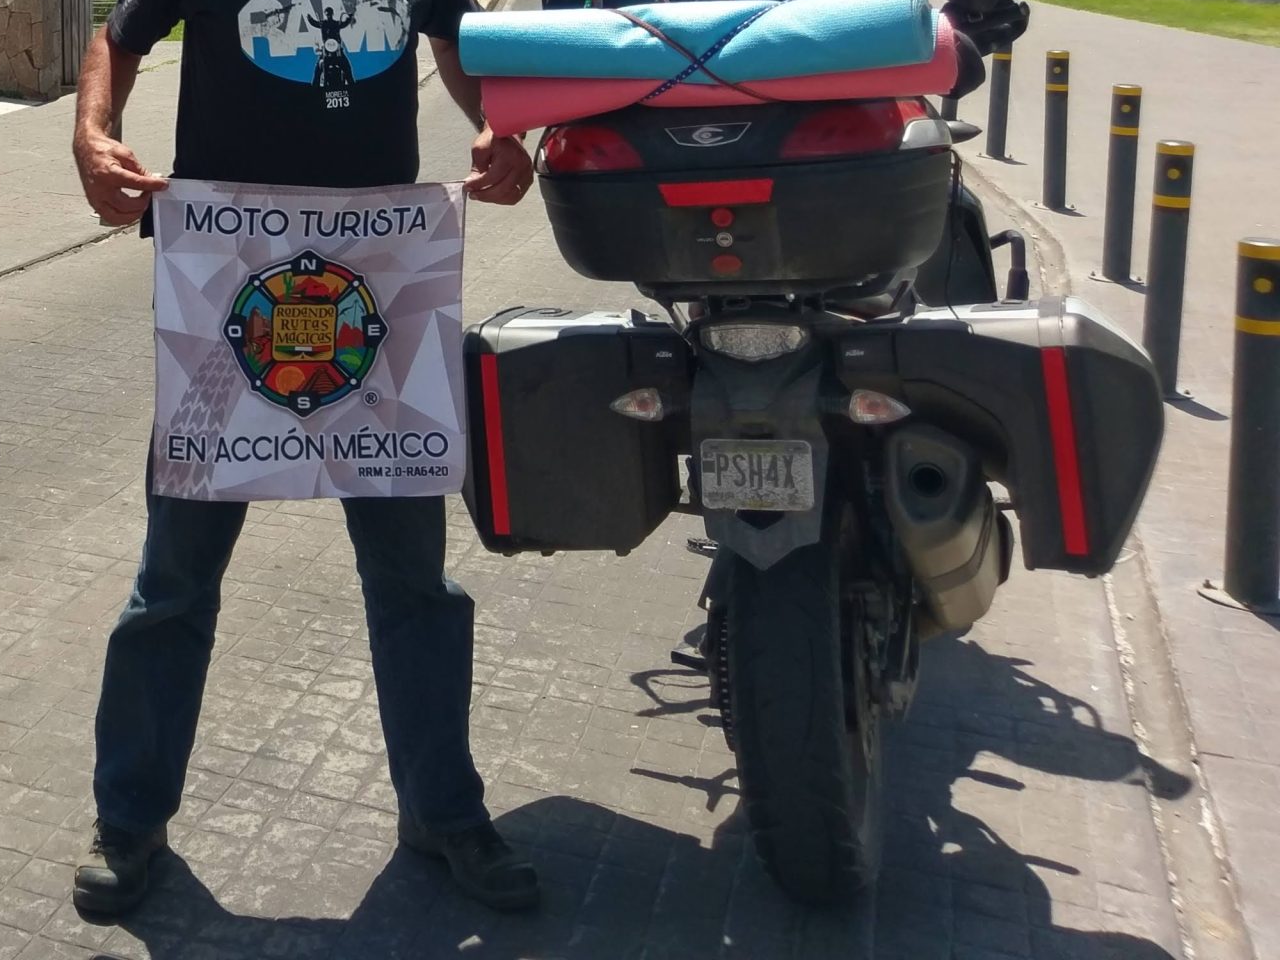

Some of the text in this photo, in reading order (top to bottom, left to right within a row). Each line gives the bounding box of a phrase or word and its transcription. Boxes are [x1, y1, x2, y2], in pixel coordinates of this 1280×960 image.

[326, 97, 350, 109] 2013
[185, 203, 427, 238] MOTO TURISTA
[300, 258, 317, 271] N
[367, 325, 381, 336] E
[297, 397, 311, 410] S
[167, 426, 449, 464] EN ACCIÓN MÉXICO
[358, 466, 383, 477] RRM
